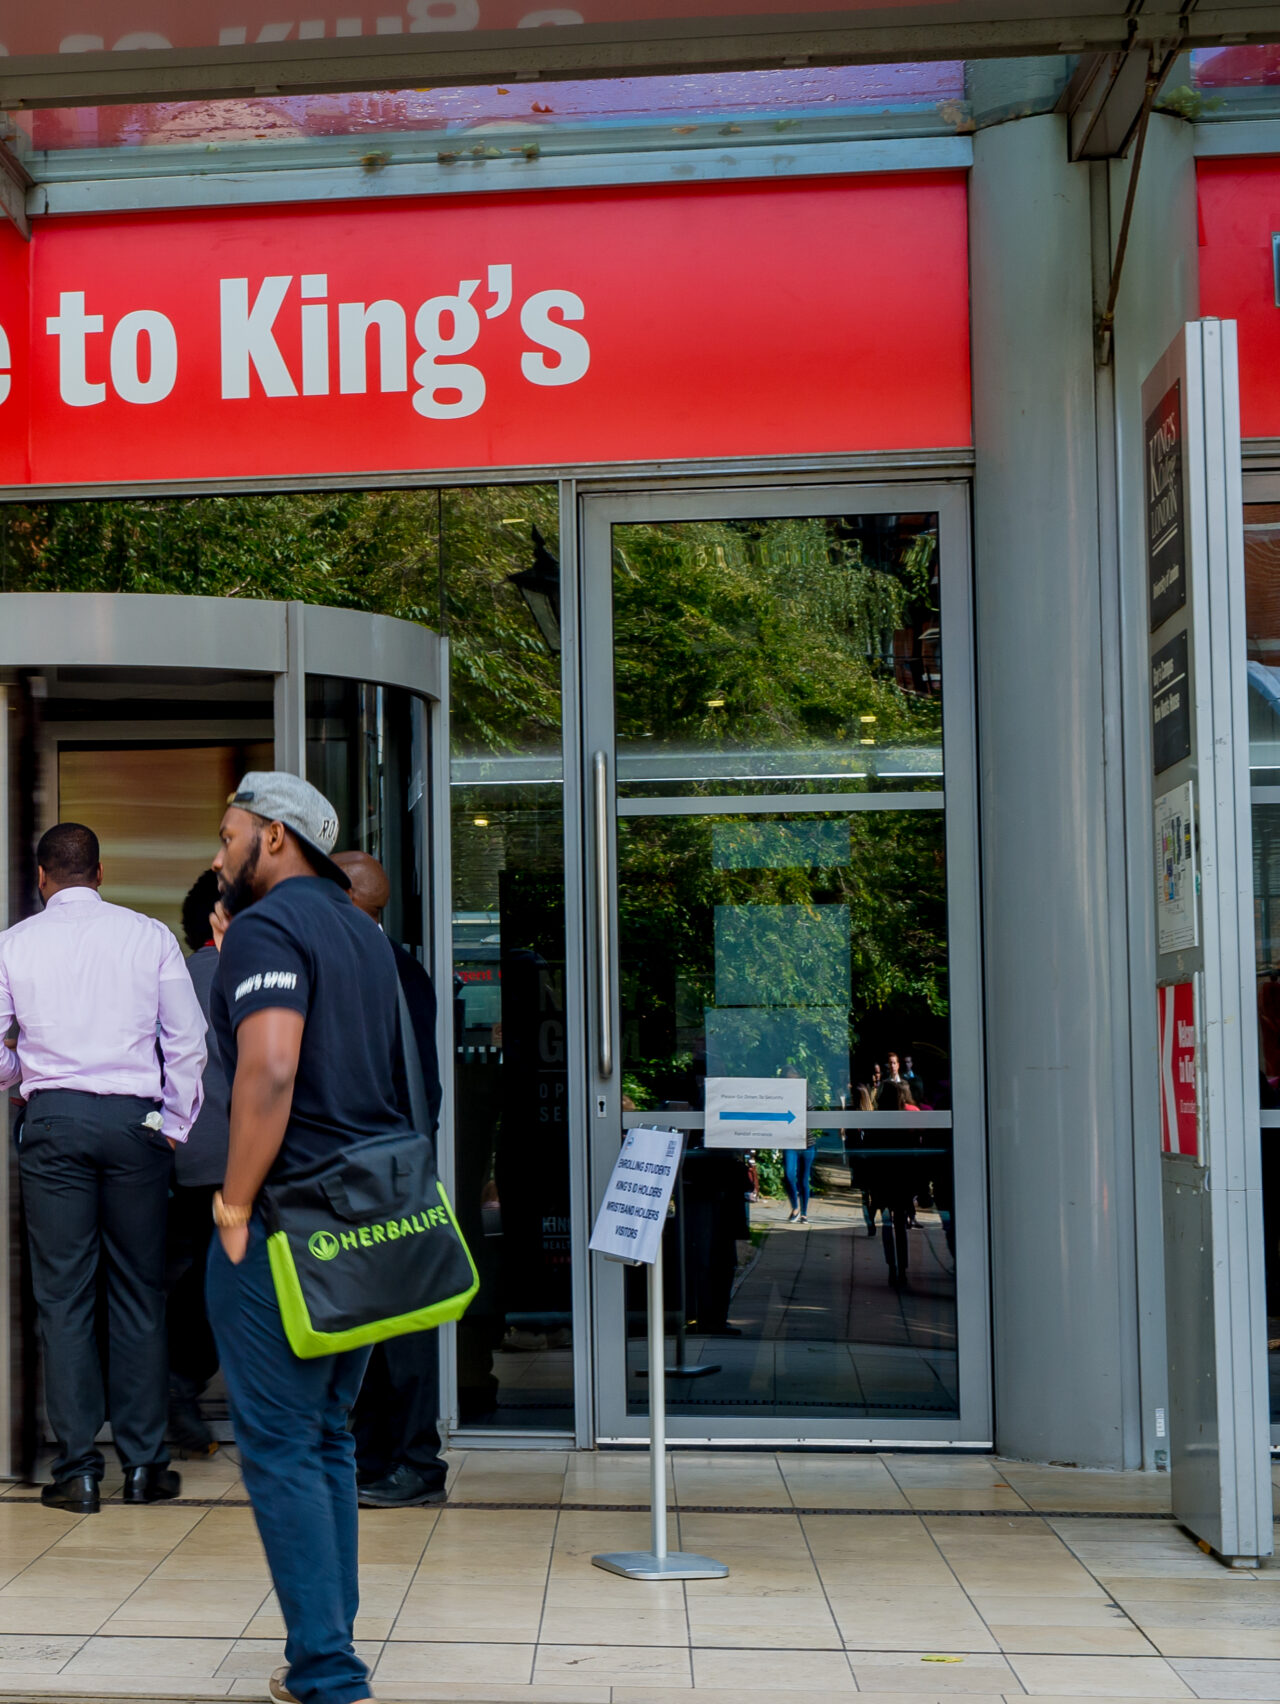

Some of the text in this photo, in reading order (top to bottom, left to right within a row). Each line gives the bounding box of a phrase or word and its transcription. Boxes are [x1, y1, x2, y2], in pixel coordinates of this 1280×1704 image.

[45, 290, 178, 407] to
[219, 263, 591, 420] King's
[263, 970, 297, 990] SPORT
[617, 1157, 671, 1177] ENROLLING STUDENTS
[631, 1182, 639, 1194] ID
[638, 1184, 663, 1198] HOLDERS
[606, 1200, 660, 1221] WRISTBAND HOLDERS
[340, 1204, 450, 1252] HERBALIFE
[615, 1225, 639, 1240] VISITORS
